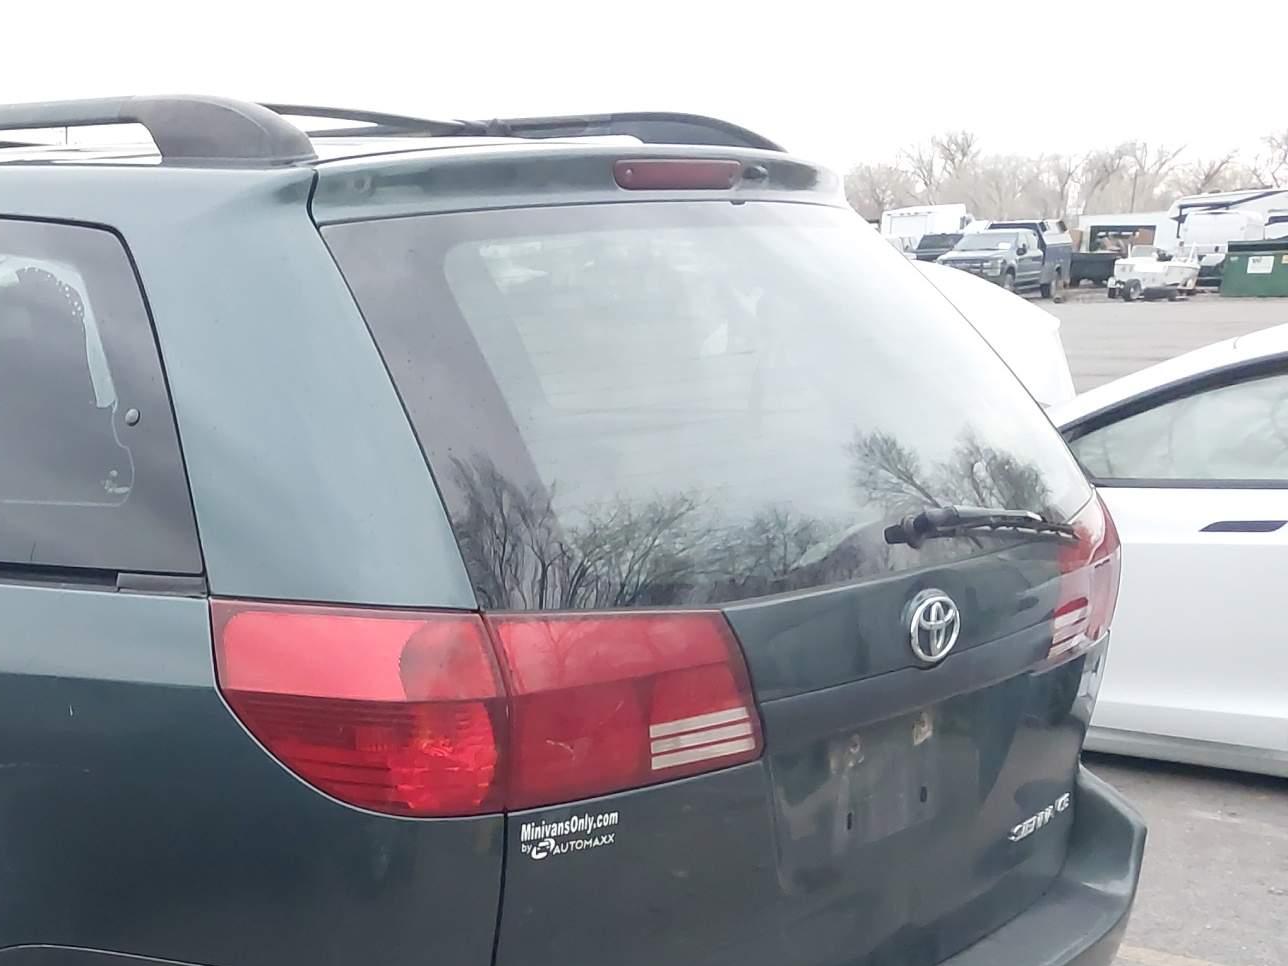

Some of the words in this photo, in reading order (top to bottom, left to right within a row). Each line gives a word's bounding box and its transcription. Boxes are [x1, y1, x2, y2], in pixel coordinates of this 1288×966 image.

[520, 811, 619, 842] MinivansOnly.com
[521, 843, 532, 855] by
[553, 833, 616, 856] AUTOMAXX
